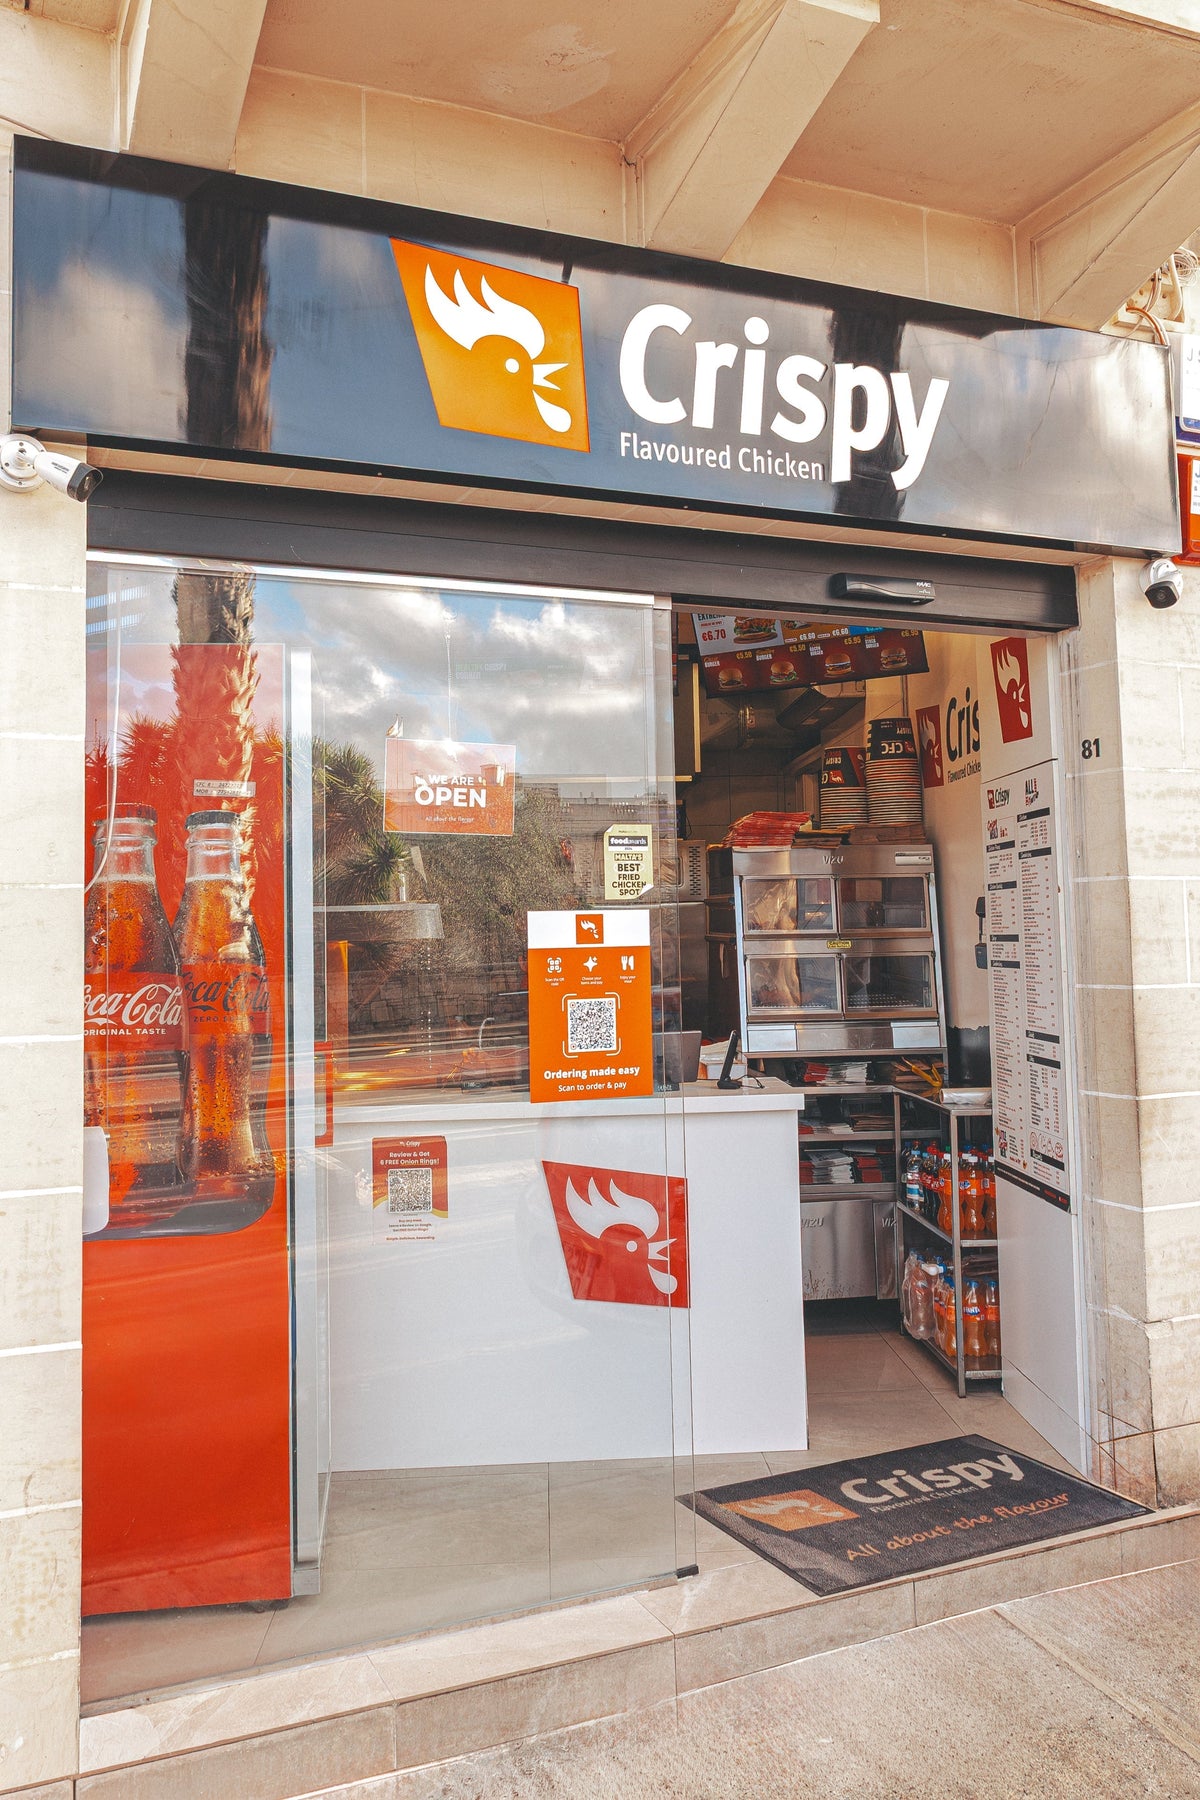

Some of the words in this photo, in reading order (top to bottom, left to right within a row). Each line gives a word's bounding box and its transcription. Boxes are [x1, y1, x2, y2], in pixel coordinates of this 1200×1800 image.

[618, 303, 950, 491] Crispy
[619, 432, 732, 470] Flavoured
[738, 448, 826, 481] Chicken
[702, 629, 727, 641] €6.70
[946, 687, 981, 762] Cris
[881, 742, 903, 754] CFC
[1081, 737, 1101, 760] 81
[966, 759, 981, 776] Chicke
[428, 775, 448, 785] WE
[451, 777, 475, 785] ARE
[414, 785, 487, 808] OPEN
[995, 787, 1010, 805] Crispy
[617, 863, 641, 872] BEST
[618, 873, 640, 881] FRIED
[611, 881, 647, 889] CHICKEN
[619, 888, 641, 896] SPOT
[84, 1028, 132, 1036] ORIGINAL
[544, 1069, 588, 1080] Ordering
[589, 1067, 616, 1077] made
[618, 1066, 640, 1076] easy
[558, 1084, 575, 1092] Scan
[586, 1082, 605, 1090] order
[614, 1081, 627, 1090] pay
[420, 1157, 439, 1165] Rings!
[840, 1453, 1024, 1504] Crispy
[869, 1494, 931, 1513] Flavoured
[931, 1486, 979, 1501] Chicken
[847, 1543, 881, 1561] All
[886, 1525, 951, 1551] about
[953, 1513, 993, 1531] the
[993, 1492, 1069, 1519] flavour
